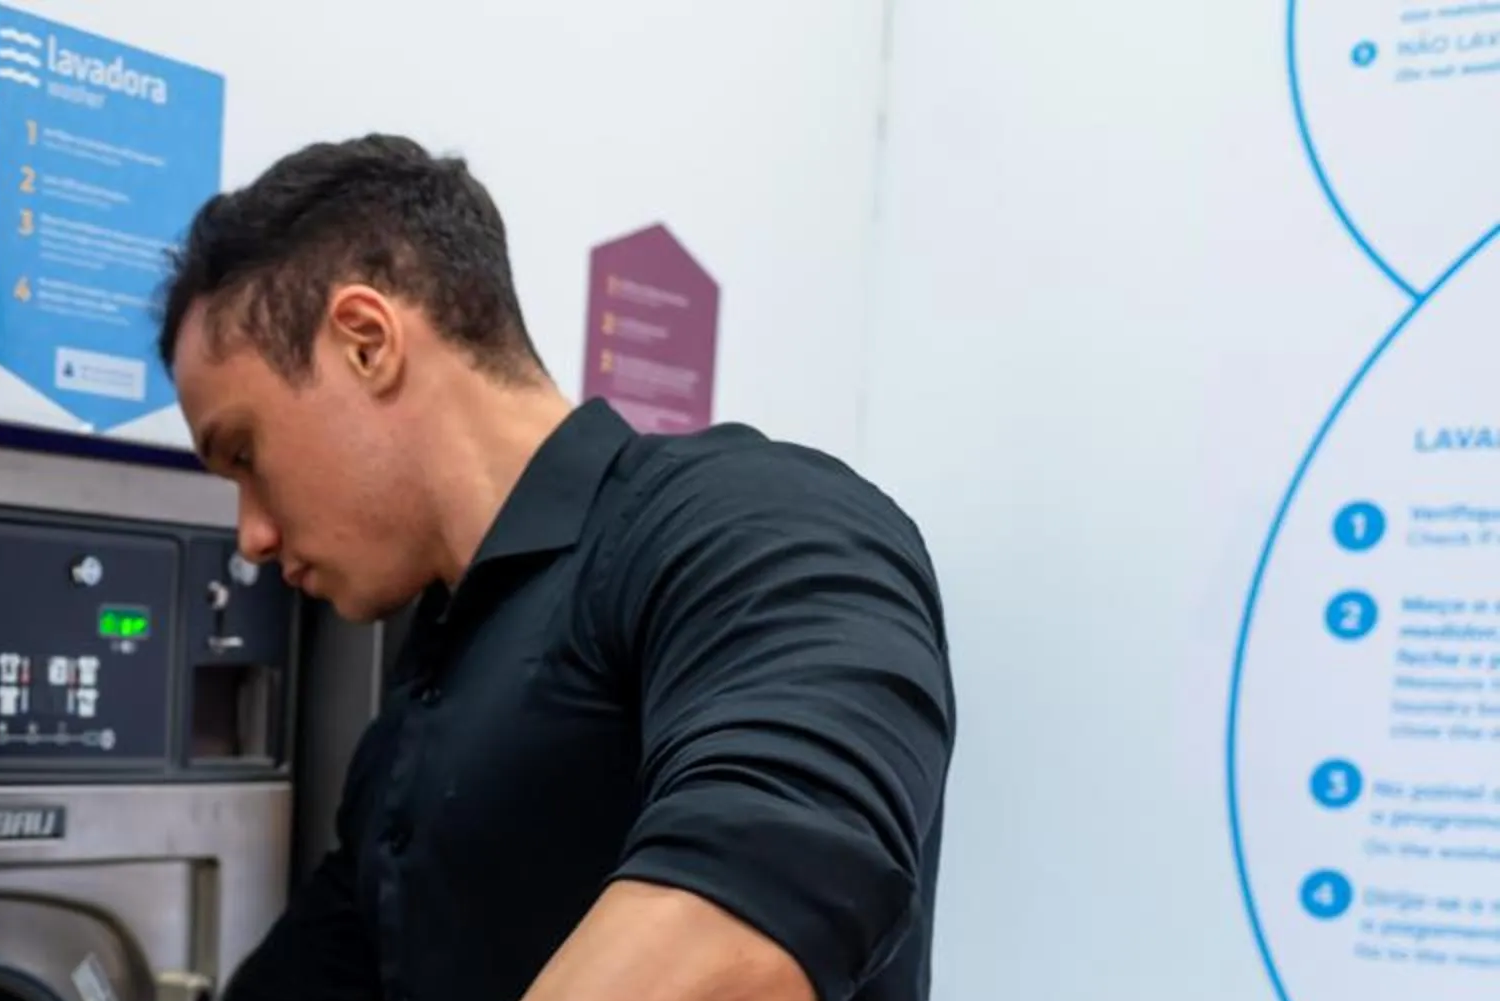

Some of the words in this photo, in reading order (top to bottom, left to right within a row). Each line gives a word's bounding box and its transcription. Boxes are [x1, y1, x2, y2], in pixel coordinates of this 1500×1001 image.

[47, 34, 169, 105] lavadora
[26, 119, 38, 146] 1
[19, 165, 36, 194] 2
[1414, 425, 1500, 454] LAVA
